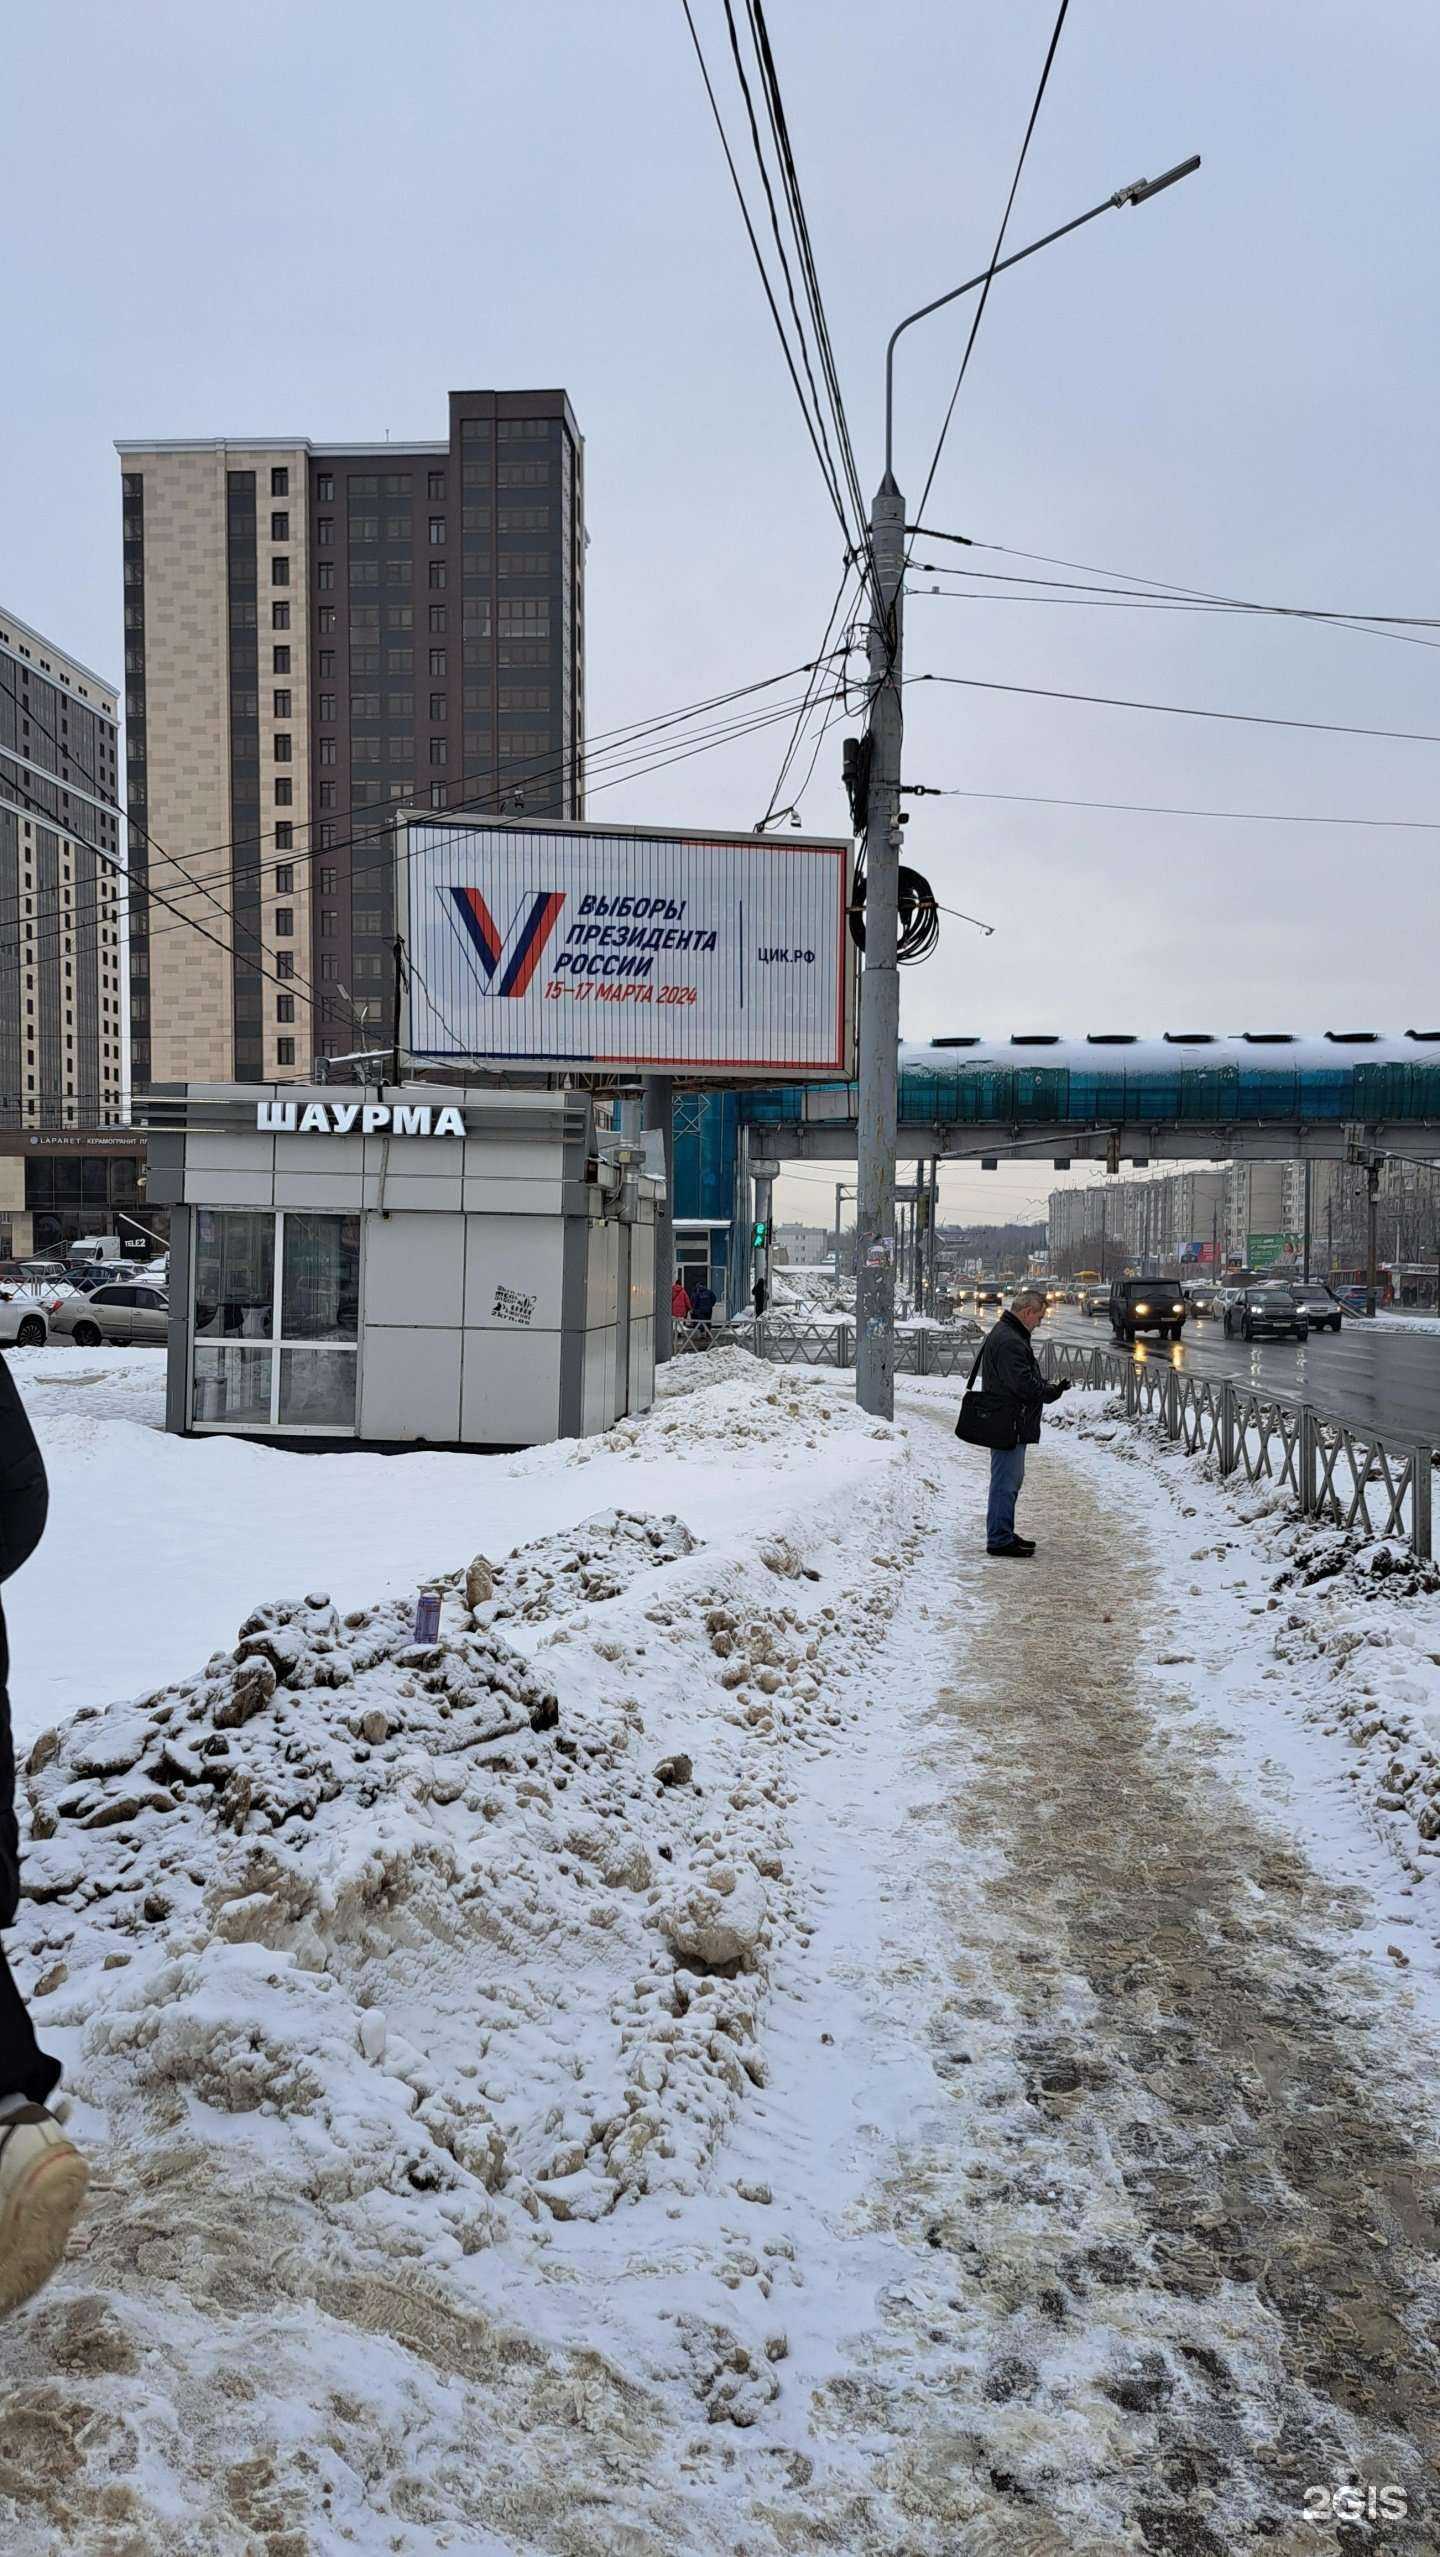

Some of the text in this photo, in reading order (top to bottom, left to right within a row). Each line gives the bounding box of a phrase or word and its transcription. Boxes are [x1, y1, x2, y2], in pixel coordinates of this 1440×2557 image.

[577, 894, 687, 920] ВЫБОРЫ
[566, 924, 718, 951] ПРЕЗИДЕНТА
[553, 953, 654, 977] РОССИИ
[758, 948, 815, 964] ЦИК.РФ
[595, 983, 654, 1003] МАРТА
[656, 986, 697, 1005] 2024
[257, 1101, 467, 1137] ШАУРМА
[125, 1238, 146, 1247] TELE2
